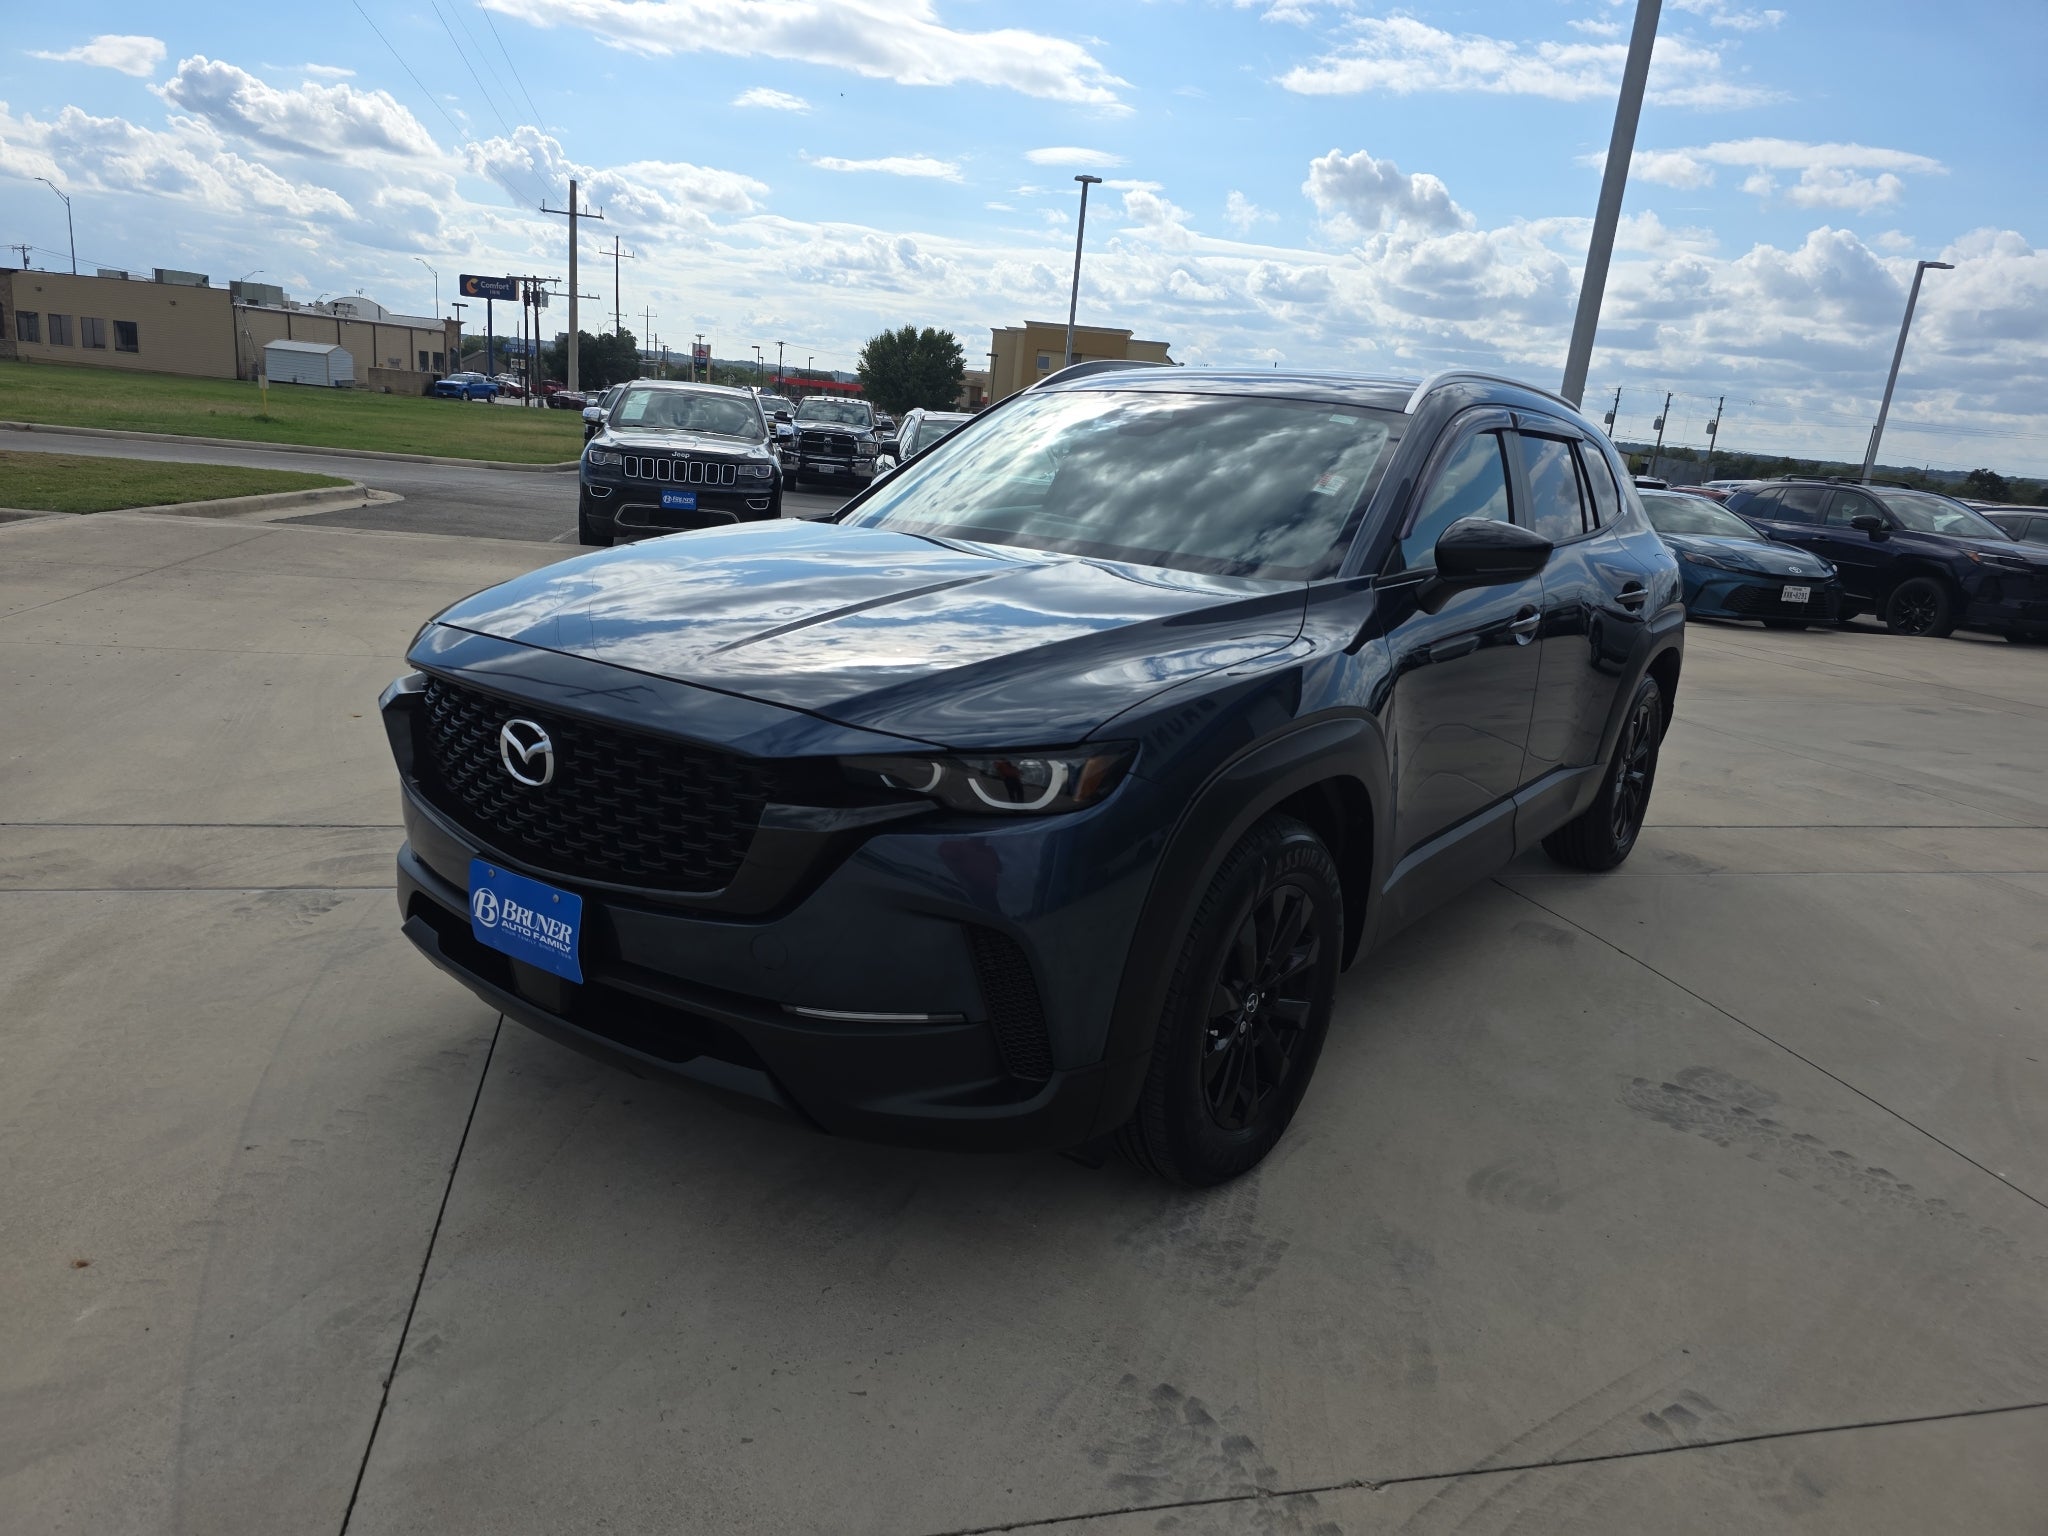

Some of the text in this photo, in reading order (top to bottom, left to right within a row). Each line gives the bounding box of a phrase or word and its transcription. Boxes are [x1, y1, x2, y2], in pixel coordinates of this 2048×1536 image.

[480, 280, 510, 291] Comfort
[671, 451, 690, 459] Jeep
[501, 898, 573, 945] BRUNER
[501, 920, 572, 954] AUTO FAMILY
